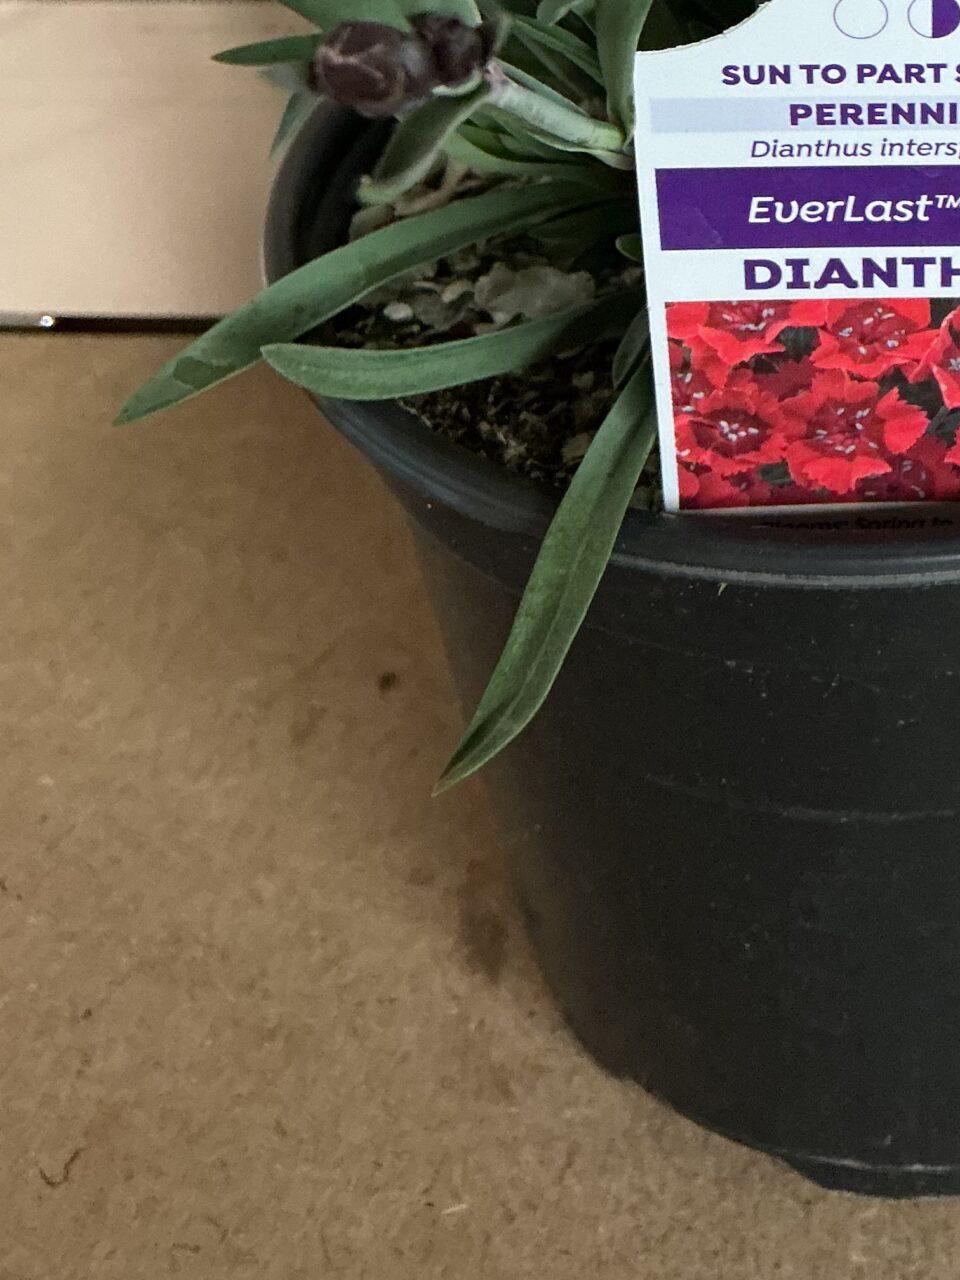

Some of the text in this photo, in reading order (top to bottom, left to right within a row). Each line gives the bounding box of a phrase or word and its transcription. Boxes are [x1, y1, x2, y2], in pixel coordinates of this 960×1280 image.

[721, 63, 792, 86] SUN
[798, 63, 848, 85] TO
[856, 62, 949, 85] PART
[750, 138, 873, 159] Dianthus
